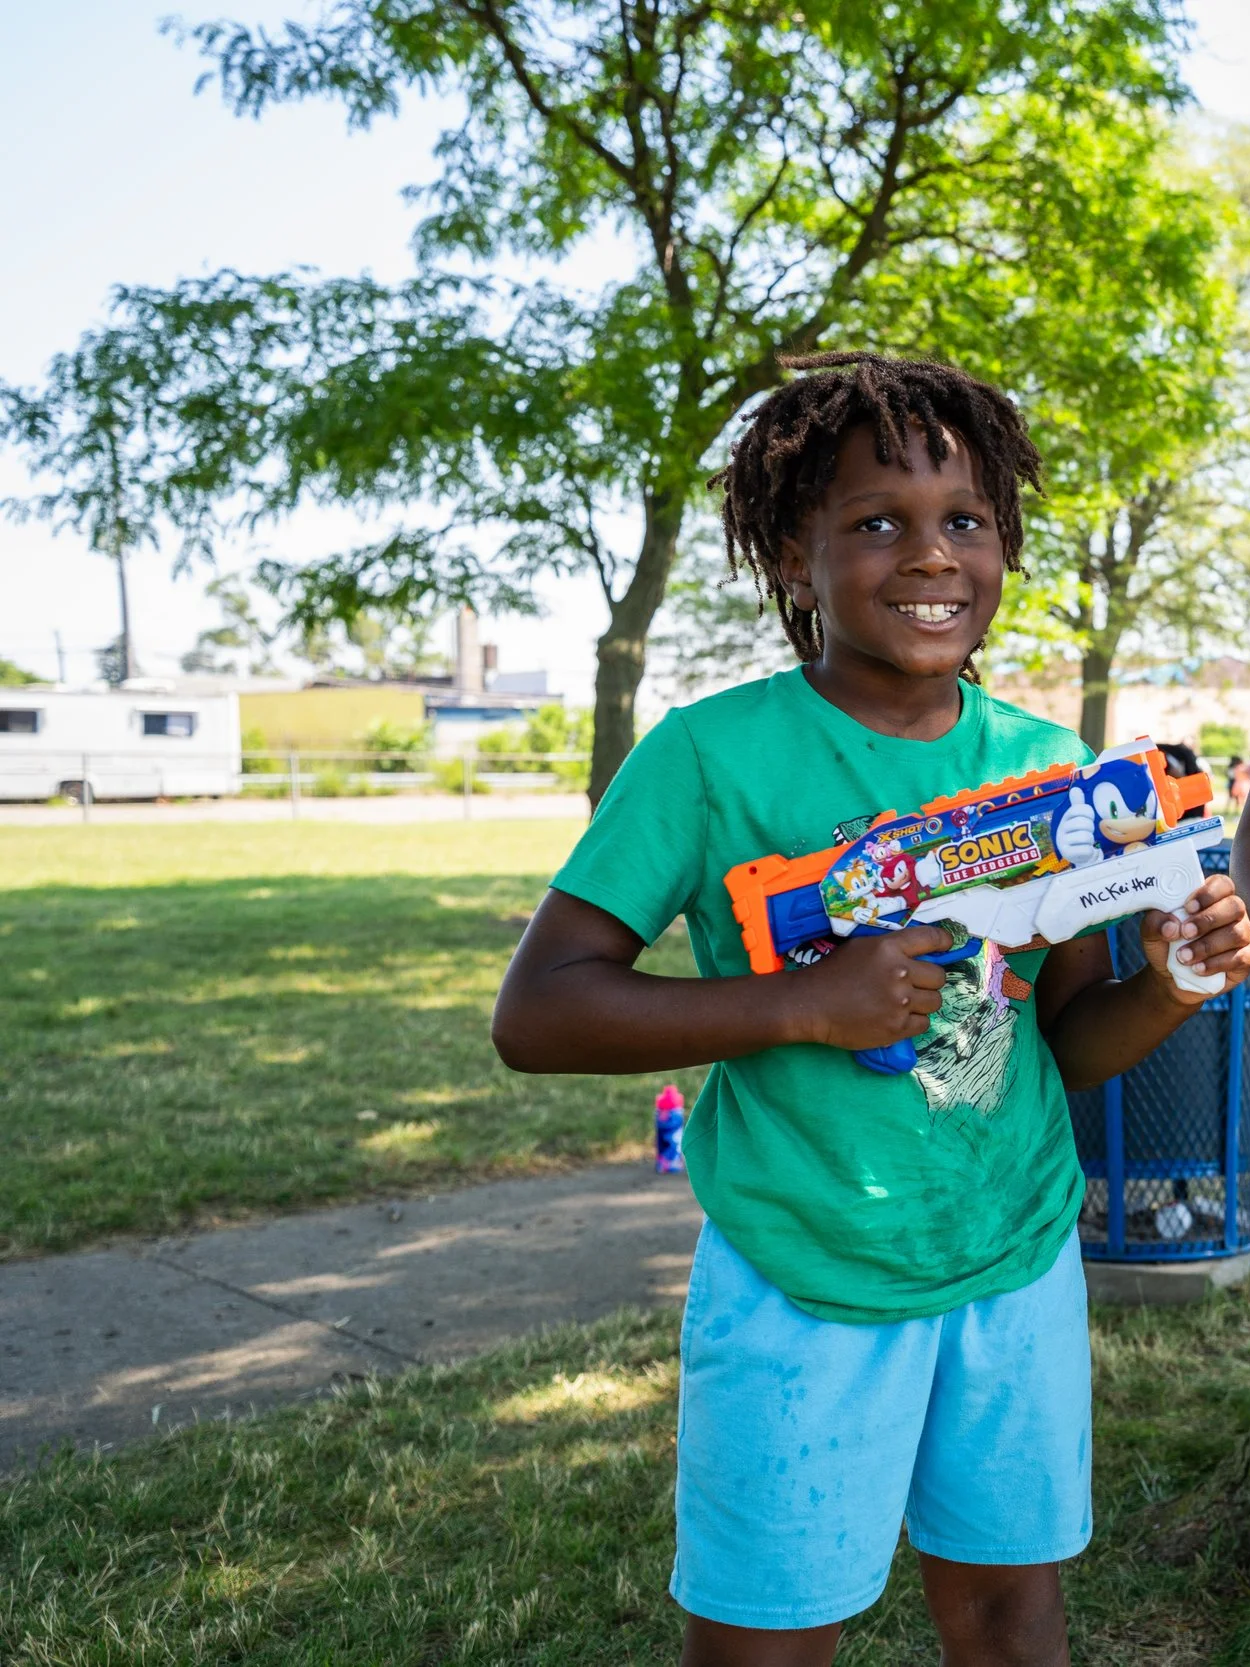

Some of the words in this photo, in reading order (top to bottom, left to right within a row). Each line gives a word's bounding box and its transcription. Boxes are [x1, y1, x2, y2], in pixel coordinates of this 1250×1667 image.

[940, 825, 1032, 871] SONIC
[945, 869, 969, 882] THE
[973, 849, 1038, 874] HEDGEHOG
